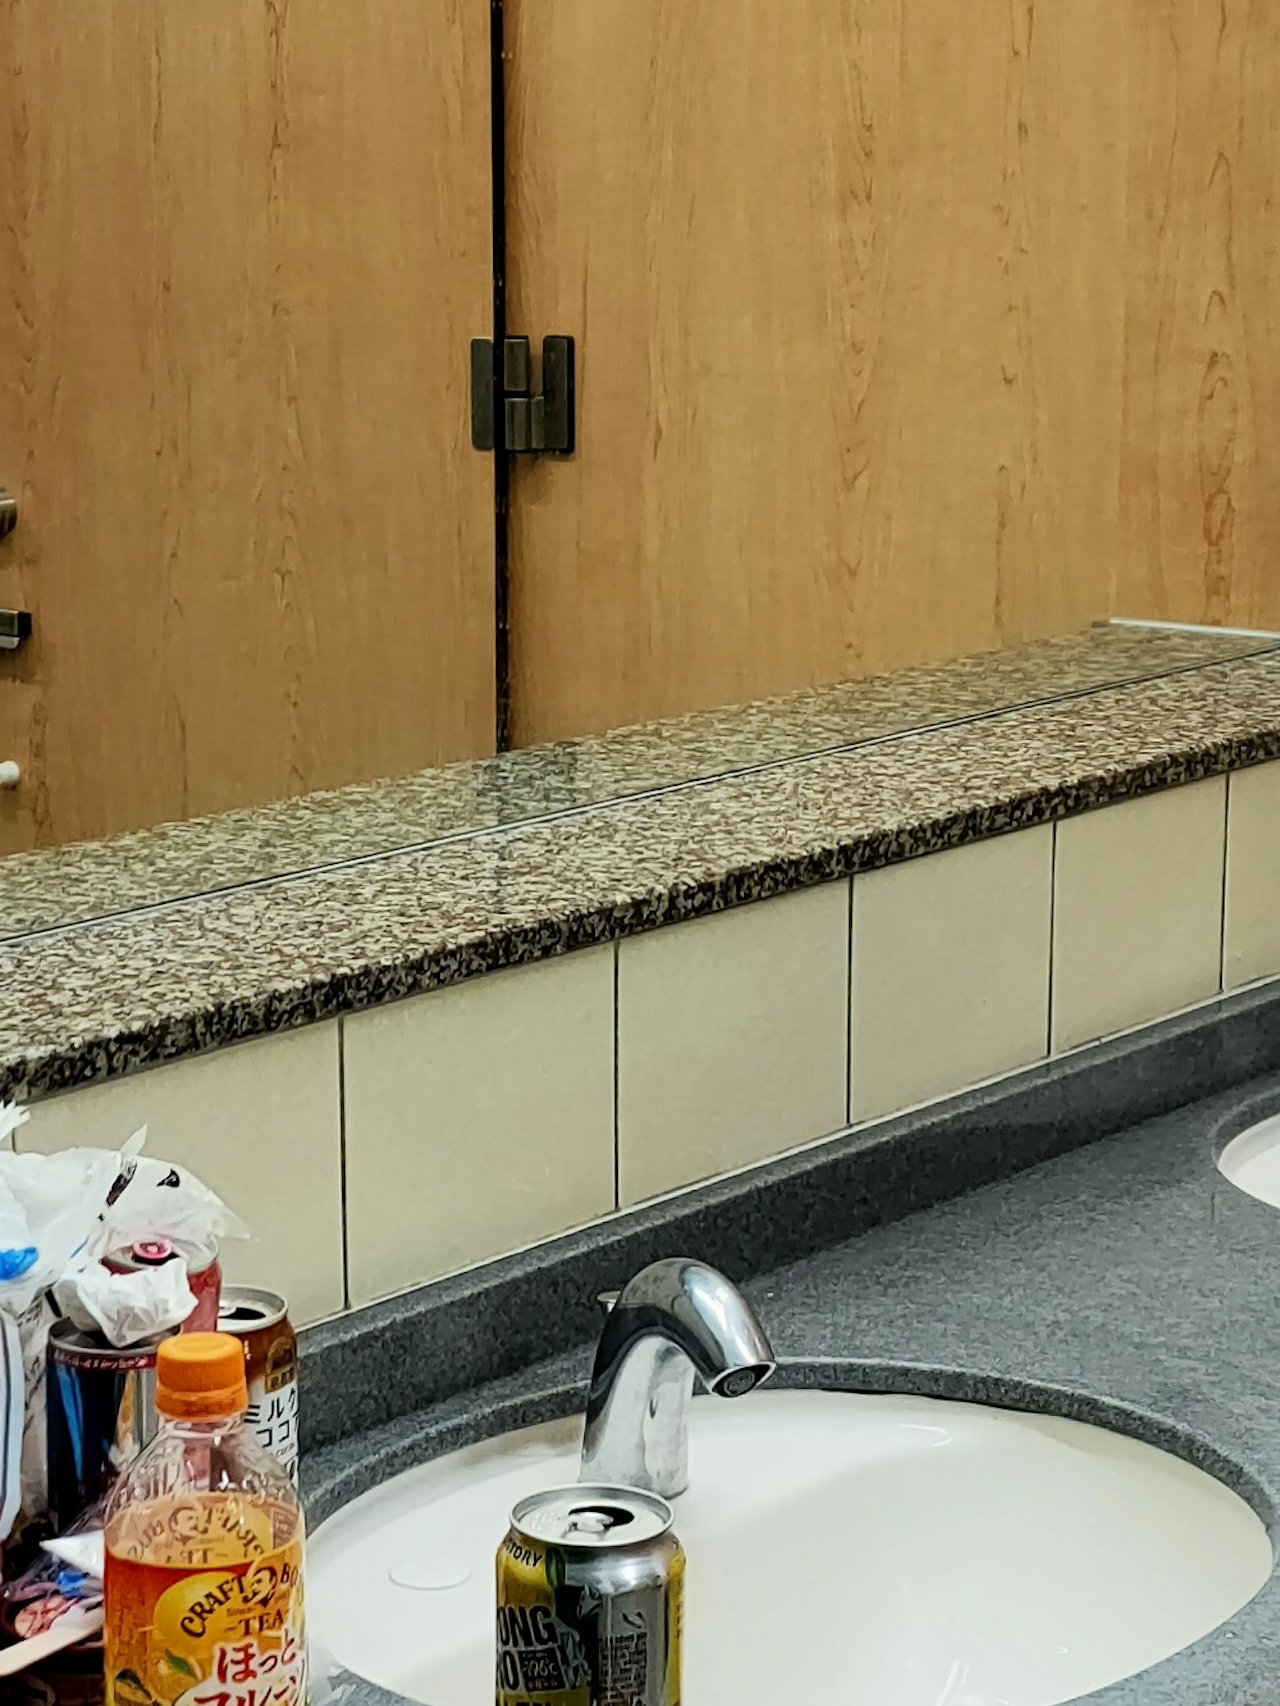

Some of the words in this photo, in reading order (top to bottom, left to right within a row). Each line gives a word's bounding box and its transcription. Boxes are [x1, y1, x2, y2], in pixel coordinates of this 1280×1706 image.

[180, 1574, 247, 1638] CRAFT
[217, 1629, 297, 1684] ほっと
